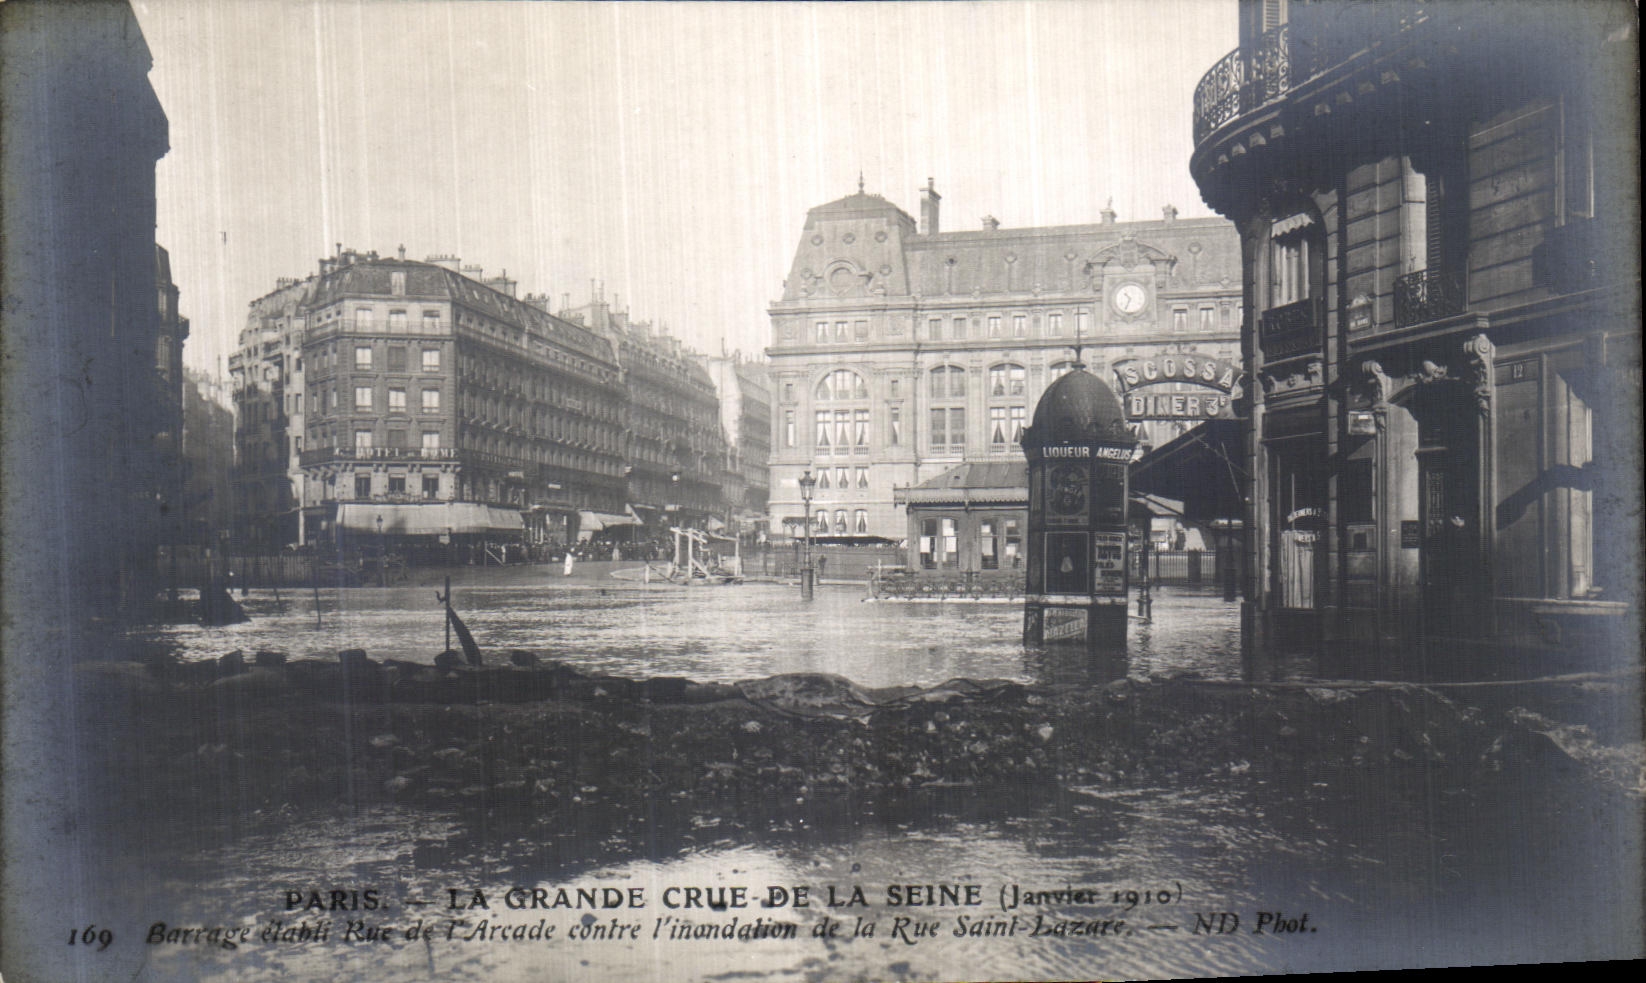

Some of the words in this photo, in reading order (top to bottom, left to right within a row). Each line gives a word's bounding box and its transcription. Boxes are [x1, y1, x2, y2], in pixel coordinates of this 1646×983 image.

[1125, 358, 1233, 388] SCOSSA
[1513, 363, 1523, 379] 12
[1131, 396, 1200, 416] DINER
[356, 447, 399, 458] HOTEL
[1042, 446, 1090, 458] LIQUEUR
[1096, 447, 1132, 460] ANGELUS
